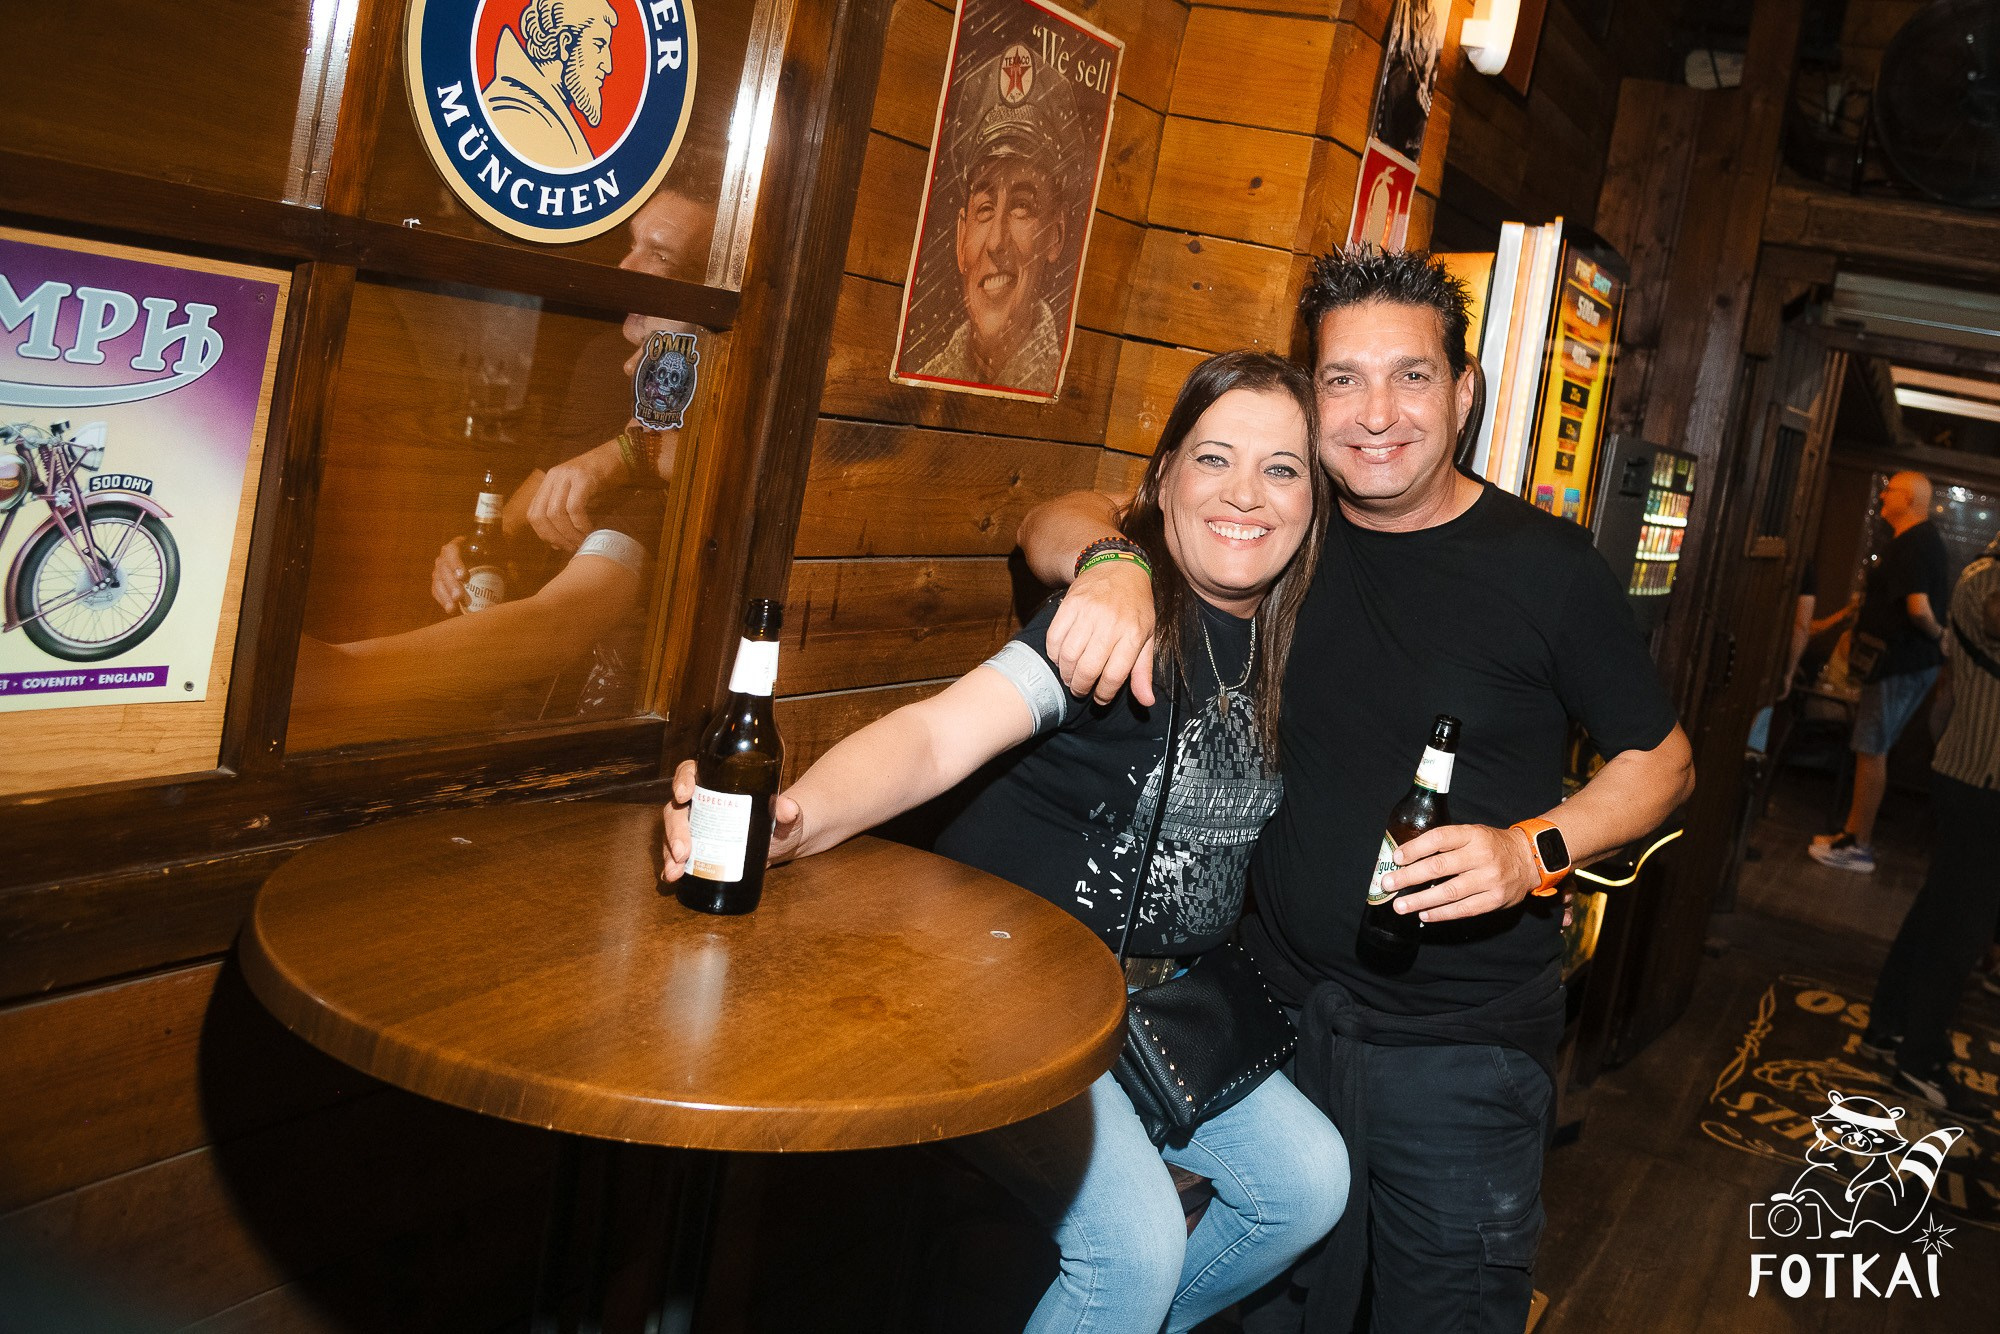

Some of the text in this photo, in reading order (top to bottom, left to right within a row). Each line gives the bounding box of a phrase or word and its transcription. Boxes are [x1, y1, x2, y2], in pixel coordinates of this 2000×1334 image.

[1075, 58, 1111, 95] sell
[437, 80, 621, 216] MÜNCHEN
[92, 475, 152, 492] 500 OHV
[22, 675, 87, 689] COVENTRY
[98, 672, 155, 684] ENGLAND
